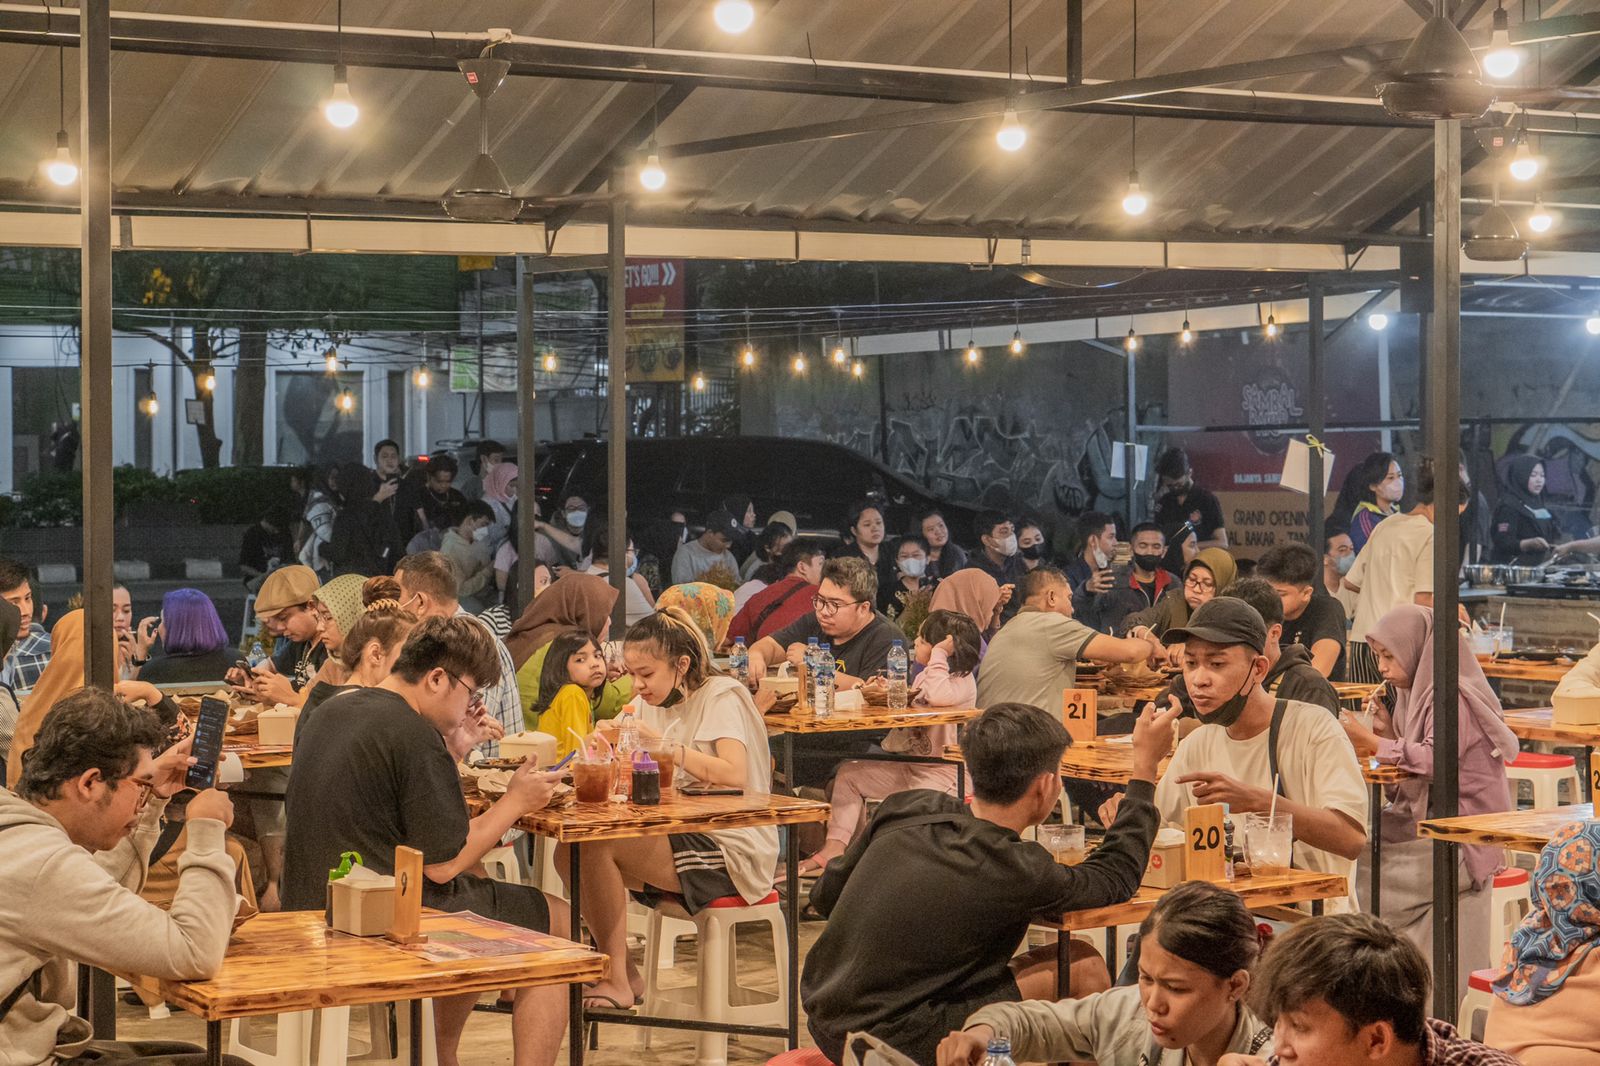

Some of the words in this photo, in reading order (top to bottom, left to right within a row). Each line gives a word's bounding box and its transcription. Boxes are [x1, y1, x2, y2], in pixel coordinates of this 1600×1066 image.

[1234, 510, 1266, 526] GRAND
[1226, 531, 1242, 546] AL
[1245, 531, 1275, 546] BAKAR
[1068, 703, 1087, 719] 21
[1192, 826, 1220, 850] 20
[401, 872, 408, 896] 9
